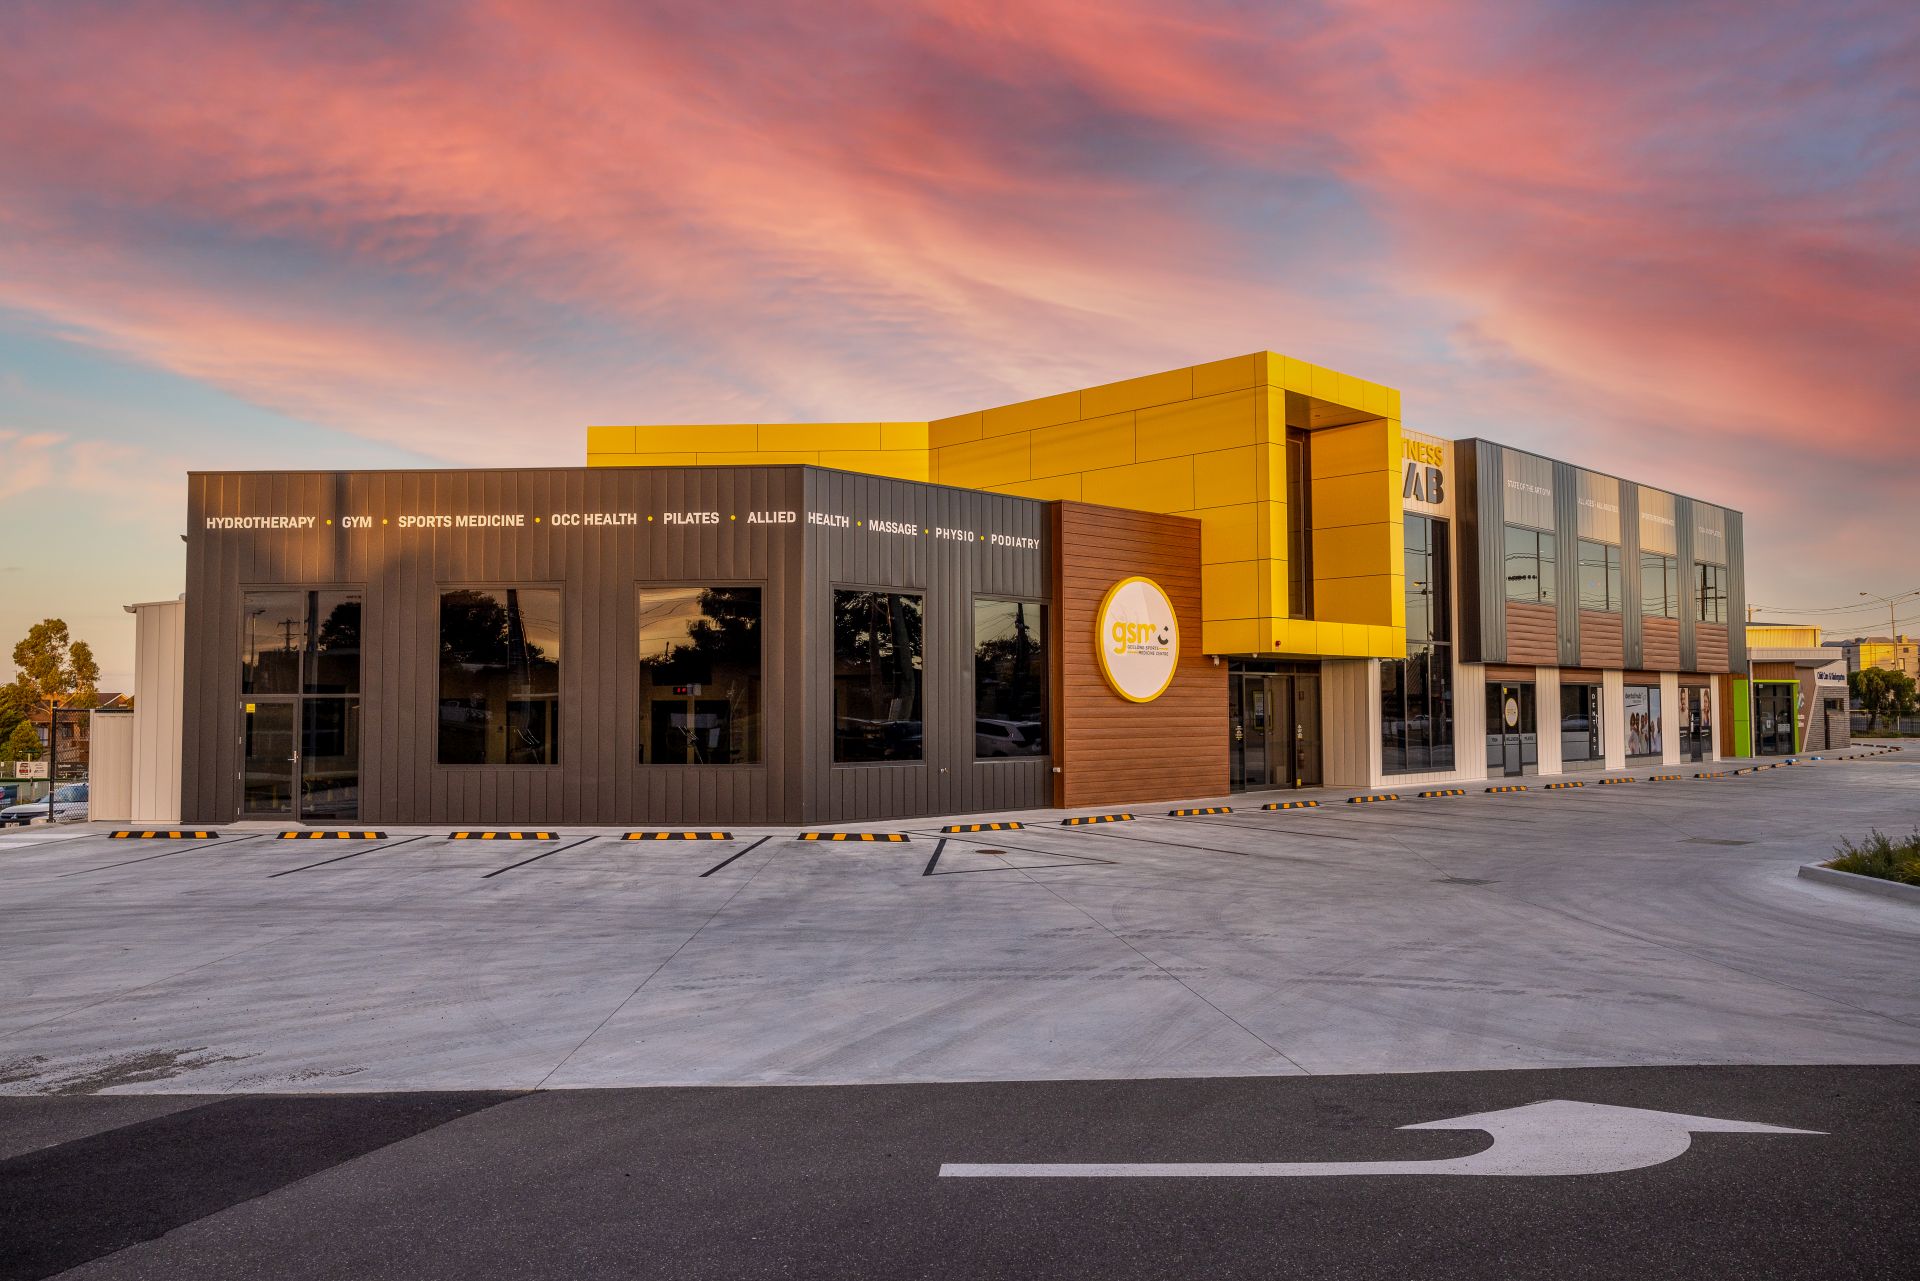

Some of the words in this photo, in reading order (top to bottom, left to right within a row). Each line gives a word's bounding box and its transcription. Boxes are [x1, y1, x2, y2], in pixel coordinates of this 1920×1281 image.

[206, 516, 316, 529] HYDROTHERAPY
[342, 516, 372, 528] GYM
[398, 515, 452, 528] SPORTS
[455, 514, 524, 527] MEDICINE
[551, 513, 580, 526] OCC
[584, 512, 637, 526] HEALTH
[663, 511, 720, 525] PILATES
[747, 511, 796, 524] ALLIED
[807, 511, 849, 528] HEALTH
[869, 519, 918, 536] MASSAGE
[935, 527, 975, 543] PHYSIO
[991, 533, 1040, 550] PODIATRY
